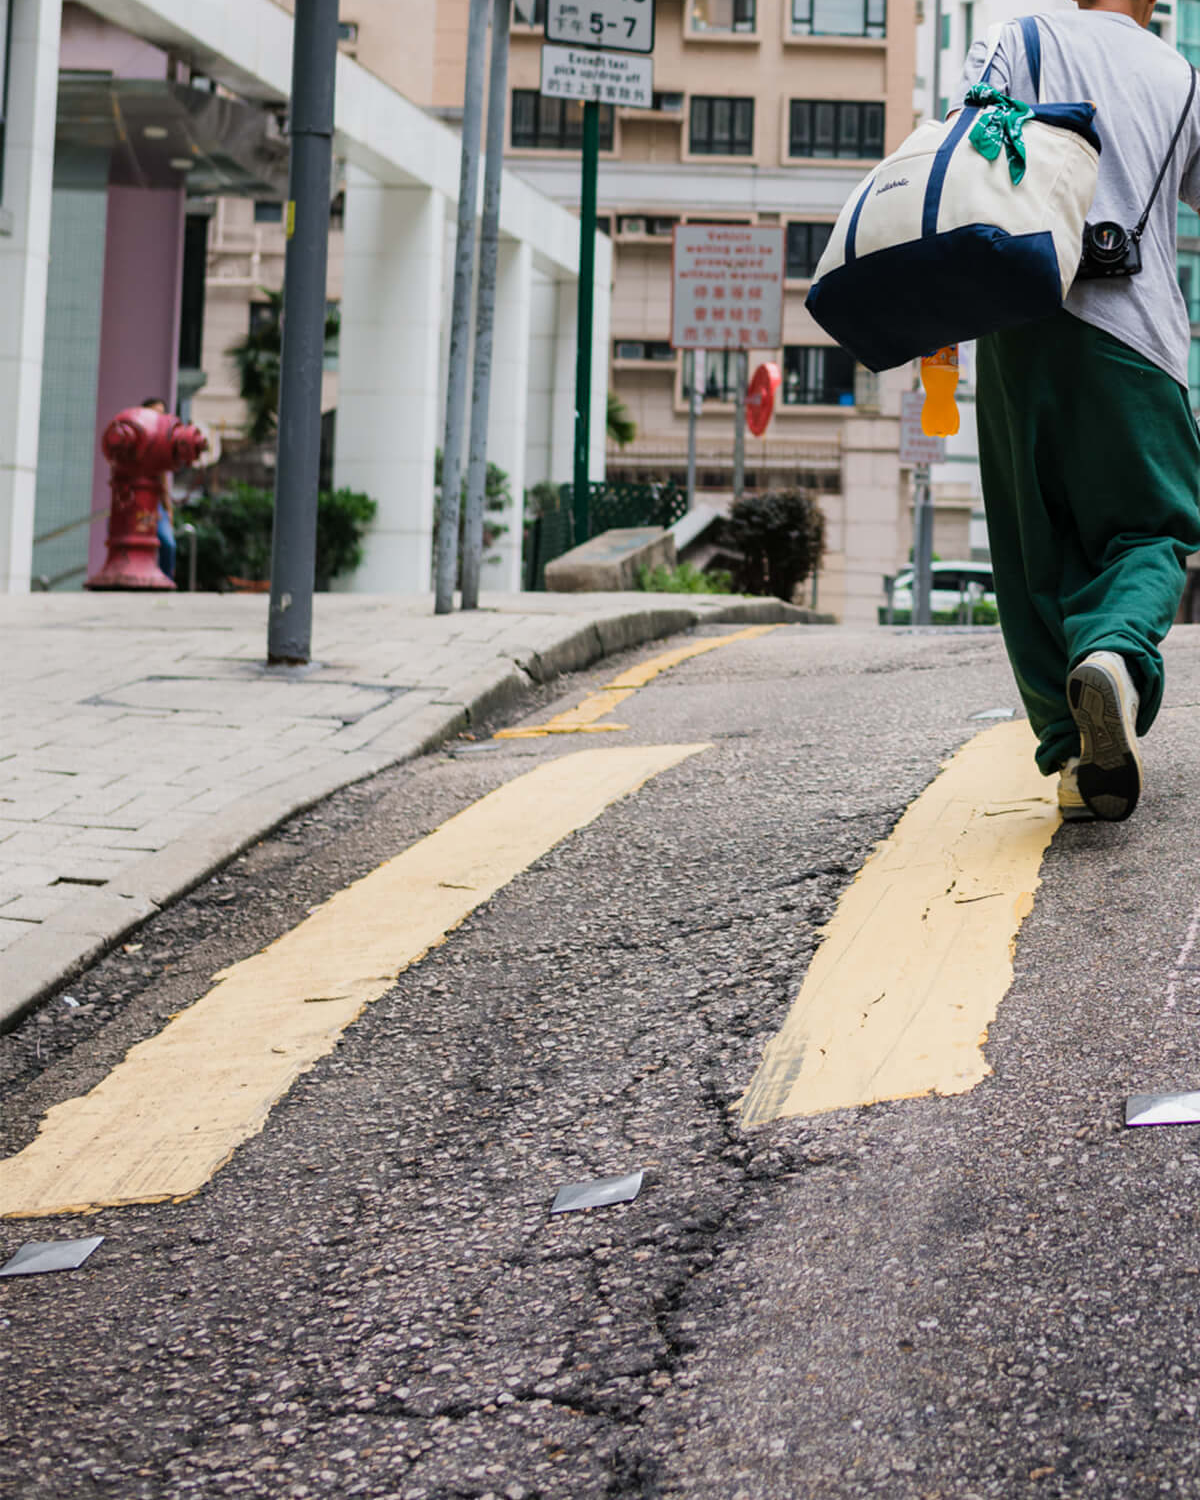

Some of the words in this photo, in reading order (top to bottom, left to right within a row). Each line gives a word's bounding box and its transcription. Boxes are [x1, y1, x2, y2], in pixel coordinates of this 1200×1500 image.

[560, 4, 578, 15] pm
[555, 18, 583, 34] 下午
[569, 53, 605, 67] Except
[608, 59, 629, 70] taxi
[554, 65, 575, 76] pick
[625, 73, 641, 84] off
